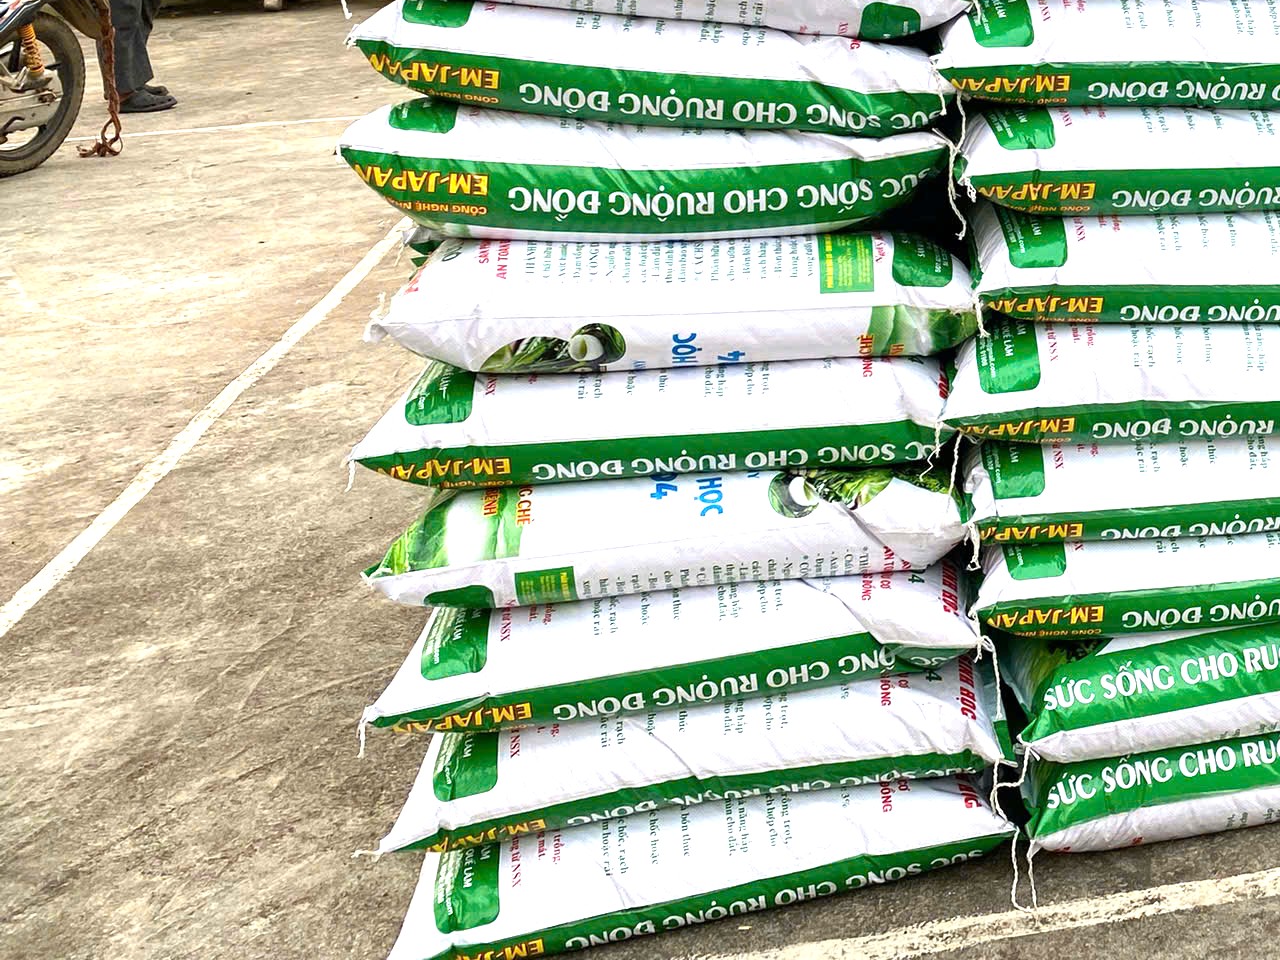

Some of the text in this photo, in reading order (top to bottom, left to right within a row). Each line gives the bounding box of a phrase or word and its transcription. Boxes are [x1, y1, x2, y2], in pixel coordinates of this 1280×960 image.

[368, 53, 501, 90] EM-JAPAN
[950, 74, 1071, 93] EM-JAPAN
[518, 82, 611, 117] ĐỒNG
[1087, 80, 1169, 104] ĐỒNG
[1175, 76, 1266, 104] RUỘNG
[618, 87, 724, 123] RUỘNG
[731, 99, 798, 126] CHO
[354, 163, 490, 196] EM-JAPAN
[978, 181, 1096, 202] EM-JAPAN
[415, 200, 488, 216] CÔNG NGHỆ
[507, 186, 602, 222] ĐỒNG
[608, 184, 715, 222] RUỘNG
[723, 187, 789, 215] CHO
[796, 179, 874, 214] SỐNG
[1111, 188, 1192, 213] ĐỒNG
[987, 296, 1105, 315] EM-JAPAN
[672, 332, 703, 364] HỌC
[1178, 413, 1274, 437] RUỘNG
[744, 448, 809, 468] CHO
[692, 476, 724, 517] HỌC
[516, 499, 535, 526] CHÈ
[986, 604, 1105, 630] EM-JAPAN
[1121, 605, 1203, 631] ĐỒNG
[652, 660, 831, 708] CHO RUỘNG
[1042, 675, 1096, 712] SỨC
[1099, 660, 1175, 701] SỐNG
[1179, 651, 1239, 685] CHO
[391, 701, 533, 734] EM-JAPAN
[1046, 772, 1098, 809] SỨC
[1101, 754, 1174, 794] SỐNG
[1178, 745, 1237, 778] CHO
[461, 866, 474, 889] LÂM
[774, 880, 839, 906] CHO
